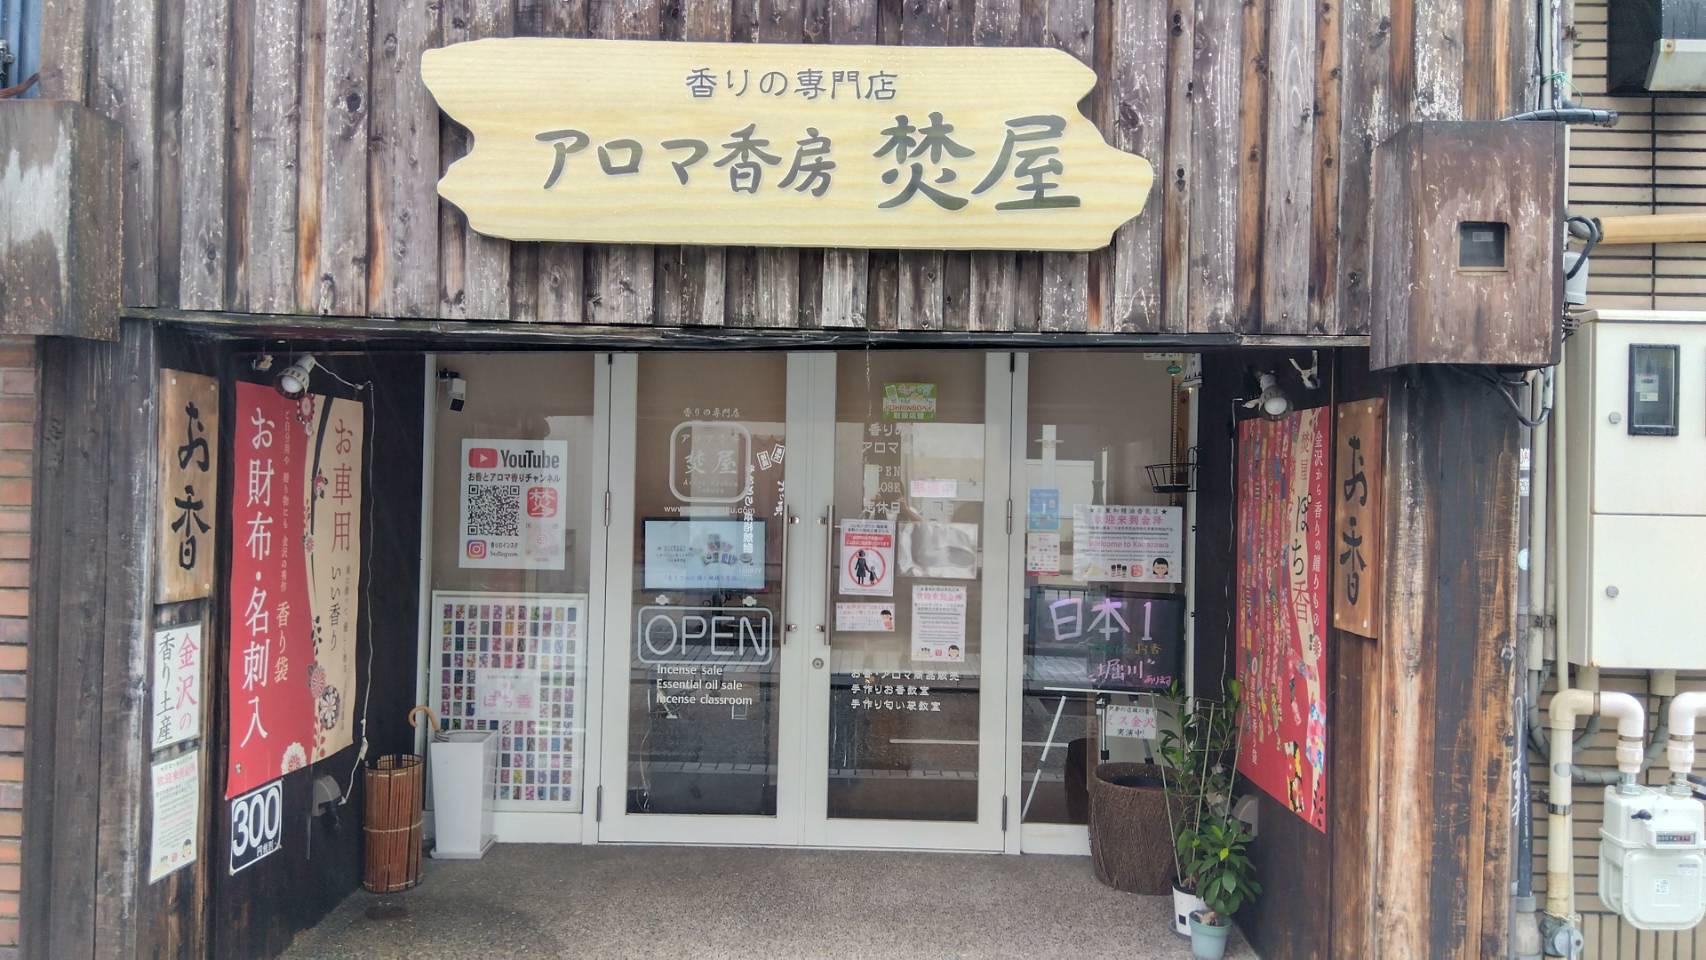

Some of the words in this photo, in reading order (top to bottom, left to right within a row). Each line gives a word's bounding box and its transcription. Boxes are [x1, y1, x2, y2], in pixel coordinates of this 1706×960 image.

[686, 67, 899, 101] 香りの専門店
[534, 121, 838, 198] アロマ香房
[874, 111, 1081, 211] 焚屋
[684, 407, 741, 419] 香りの専門店
[171, 401, 211, 570] お香
[332, 419, 353, 552] お車用
[467, 472, 561, 483] お香とアロマ香りチャンネル
[500, 449, 560, 470] YouTube
[1339, 435, 1368, 606] お香
[241, 407, 275, 748] お財布・名刺入
[273, 601, 291, 684] 香り袋
[645, 614, 767, 656] OPEN
[657, 664, 697, 675] Incense
[702, 665, 723, 675] sale
[156, 631, 175, 744] 香り土産
[175, 632, 199, 731] 金沢の
[656, 678, 702, 689] Essential
[705, 679, 718, 690] oil
[721, 680, 743, 691] sale
[656, 693, 697, 704] Incense
[700, 694, 753, 705] classroom
[232, 786, 280, 857] 300
